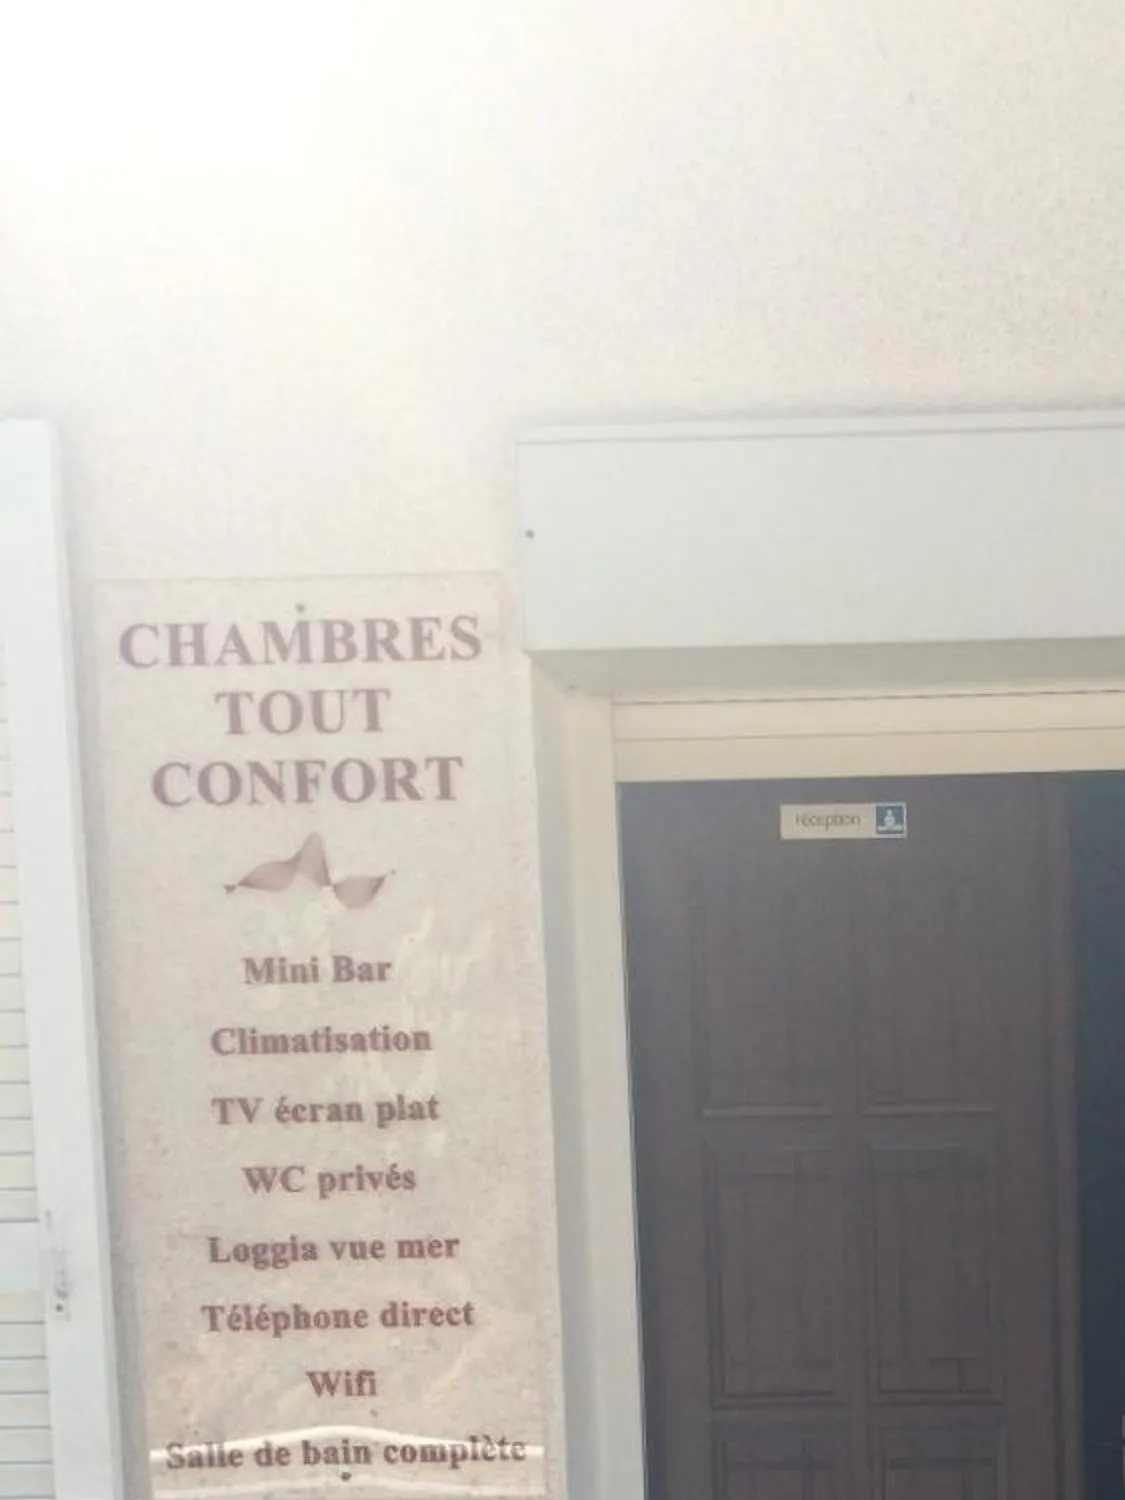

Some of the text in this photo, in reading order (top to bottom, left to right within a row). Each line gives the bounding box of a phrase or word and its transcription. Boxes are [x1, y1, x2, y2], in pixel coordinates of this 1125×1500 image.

[119, 615, 482, 669] CHAMBRES
[214, 688, 391, 735] TOUT
[151, 756, 464, 808] CONFORT
[242, 954, 392, 985] Mini Bar
[211, 1025, 432, 1056] Climatisation
[211, 1093, 440, 1129] TV écran plat
[241, 1162, 416, 1200] WC privés
[208, 1234, 460, 1270] Loggia vue mer
[202, 1300, 475, 1338] Téléphone direct
[306, 1369, 377, 1398] Wifi
[255, 1440, 291, 1468] de
[302, 1438, 371, 1466] bain
[384, 1433, 527, 1470] complète
